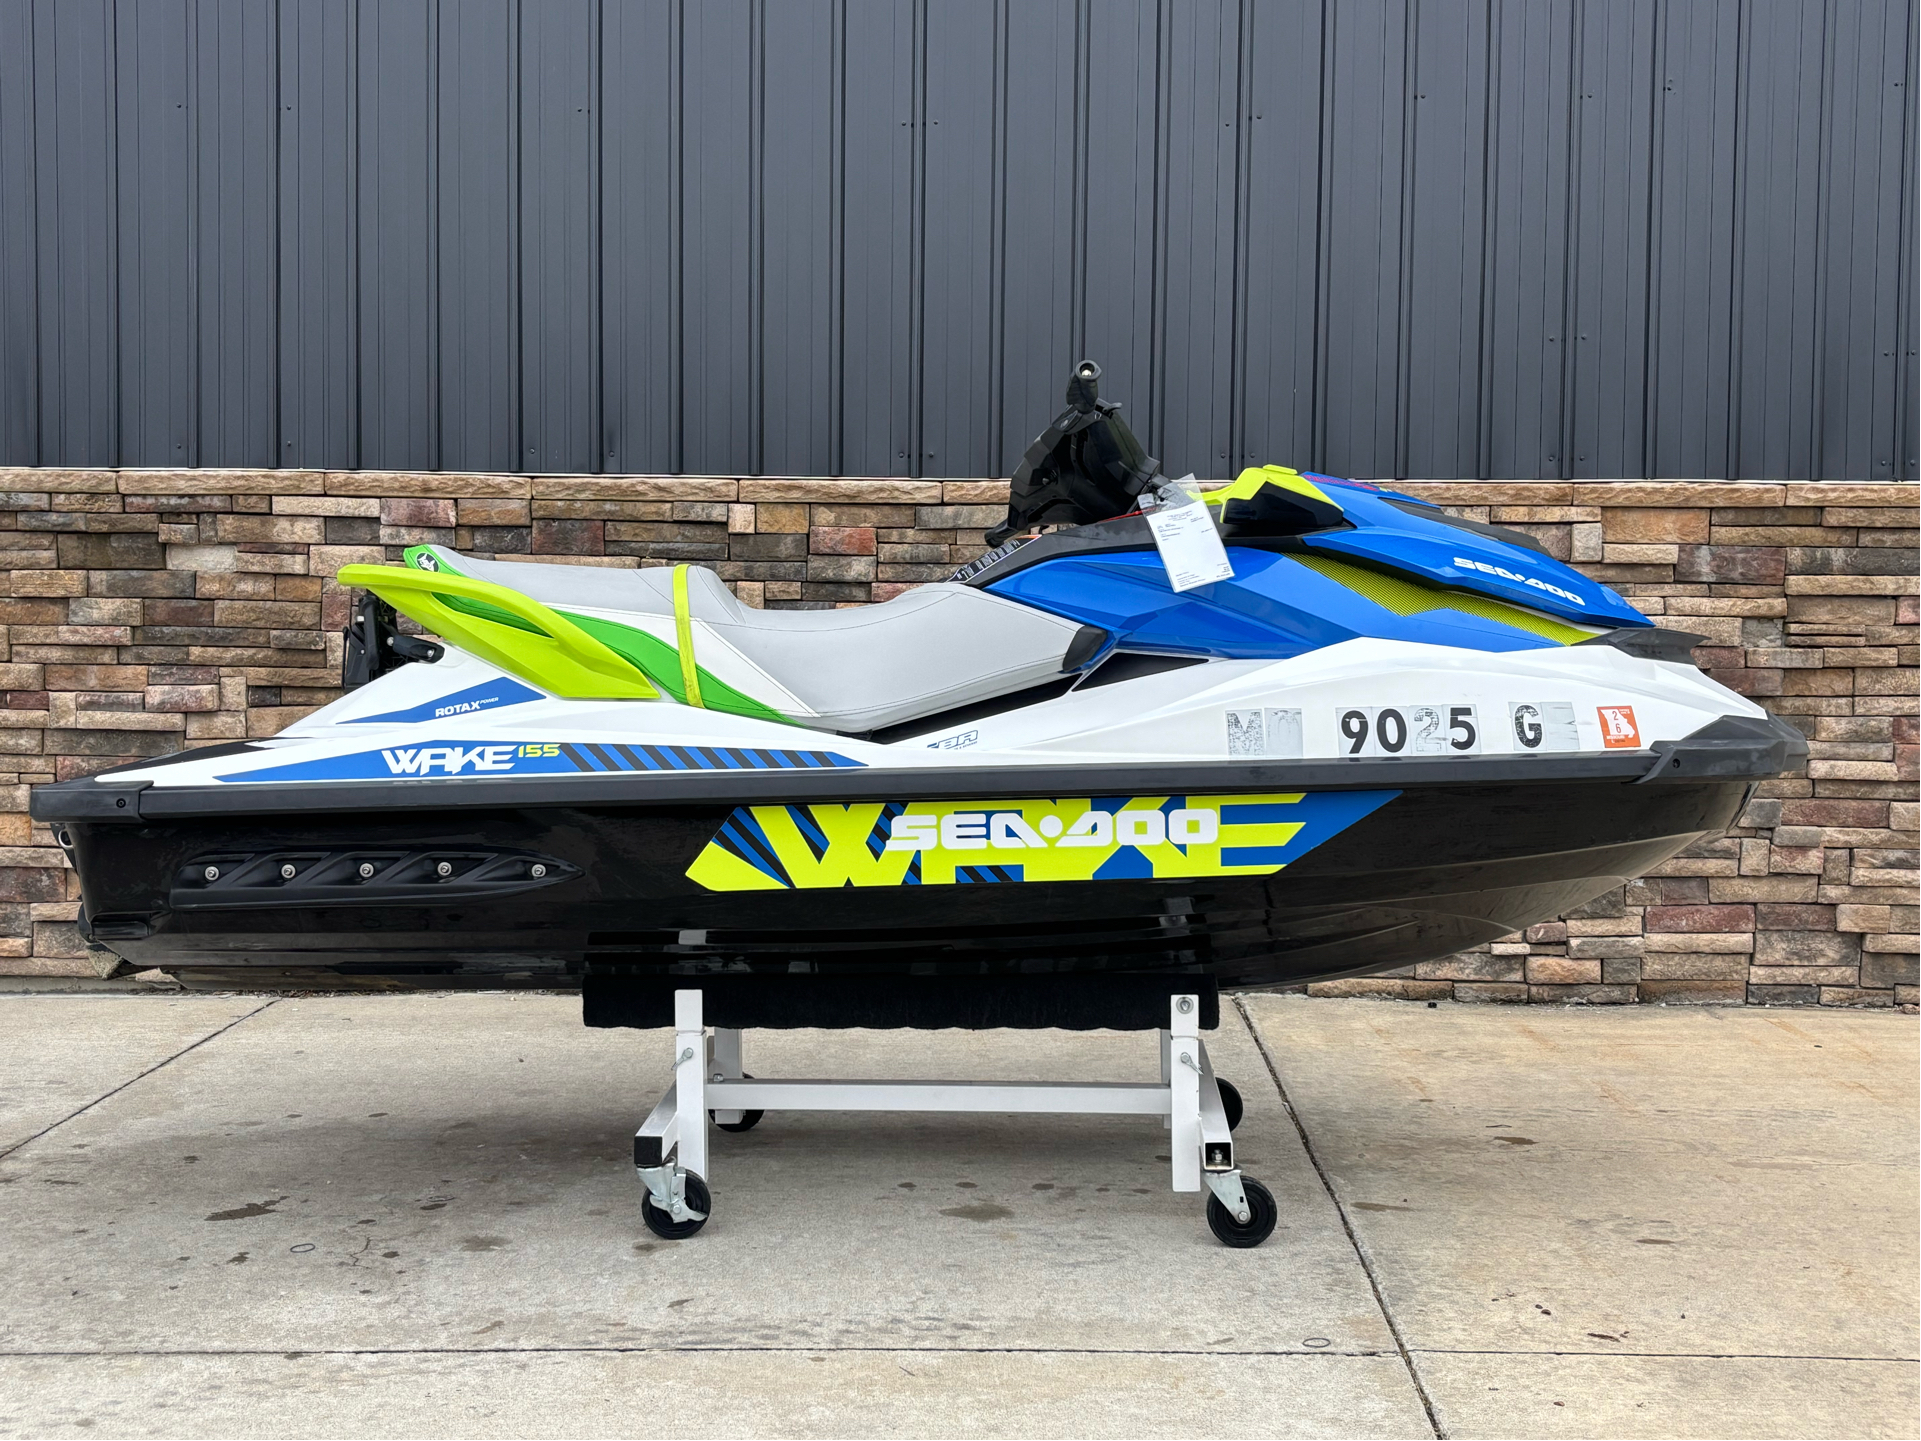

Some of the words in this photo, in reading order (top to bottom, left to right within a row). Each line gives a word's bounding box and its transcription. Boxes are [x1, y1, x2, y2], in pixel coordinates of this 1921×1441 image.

[435, 701, 480, 717] ROTAX
[1612, 711, 1619, 720] 2
[1341, 707, 1476, 754] 9025
[1615, 723, 1622, 733] 6
[381, 745, 518, 776] WAKE
[518, 744, 561, 758] 155
